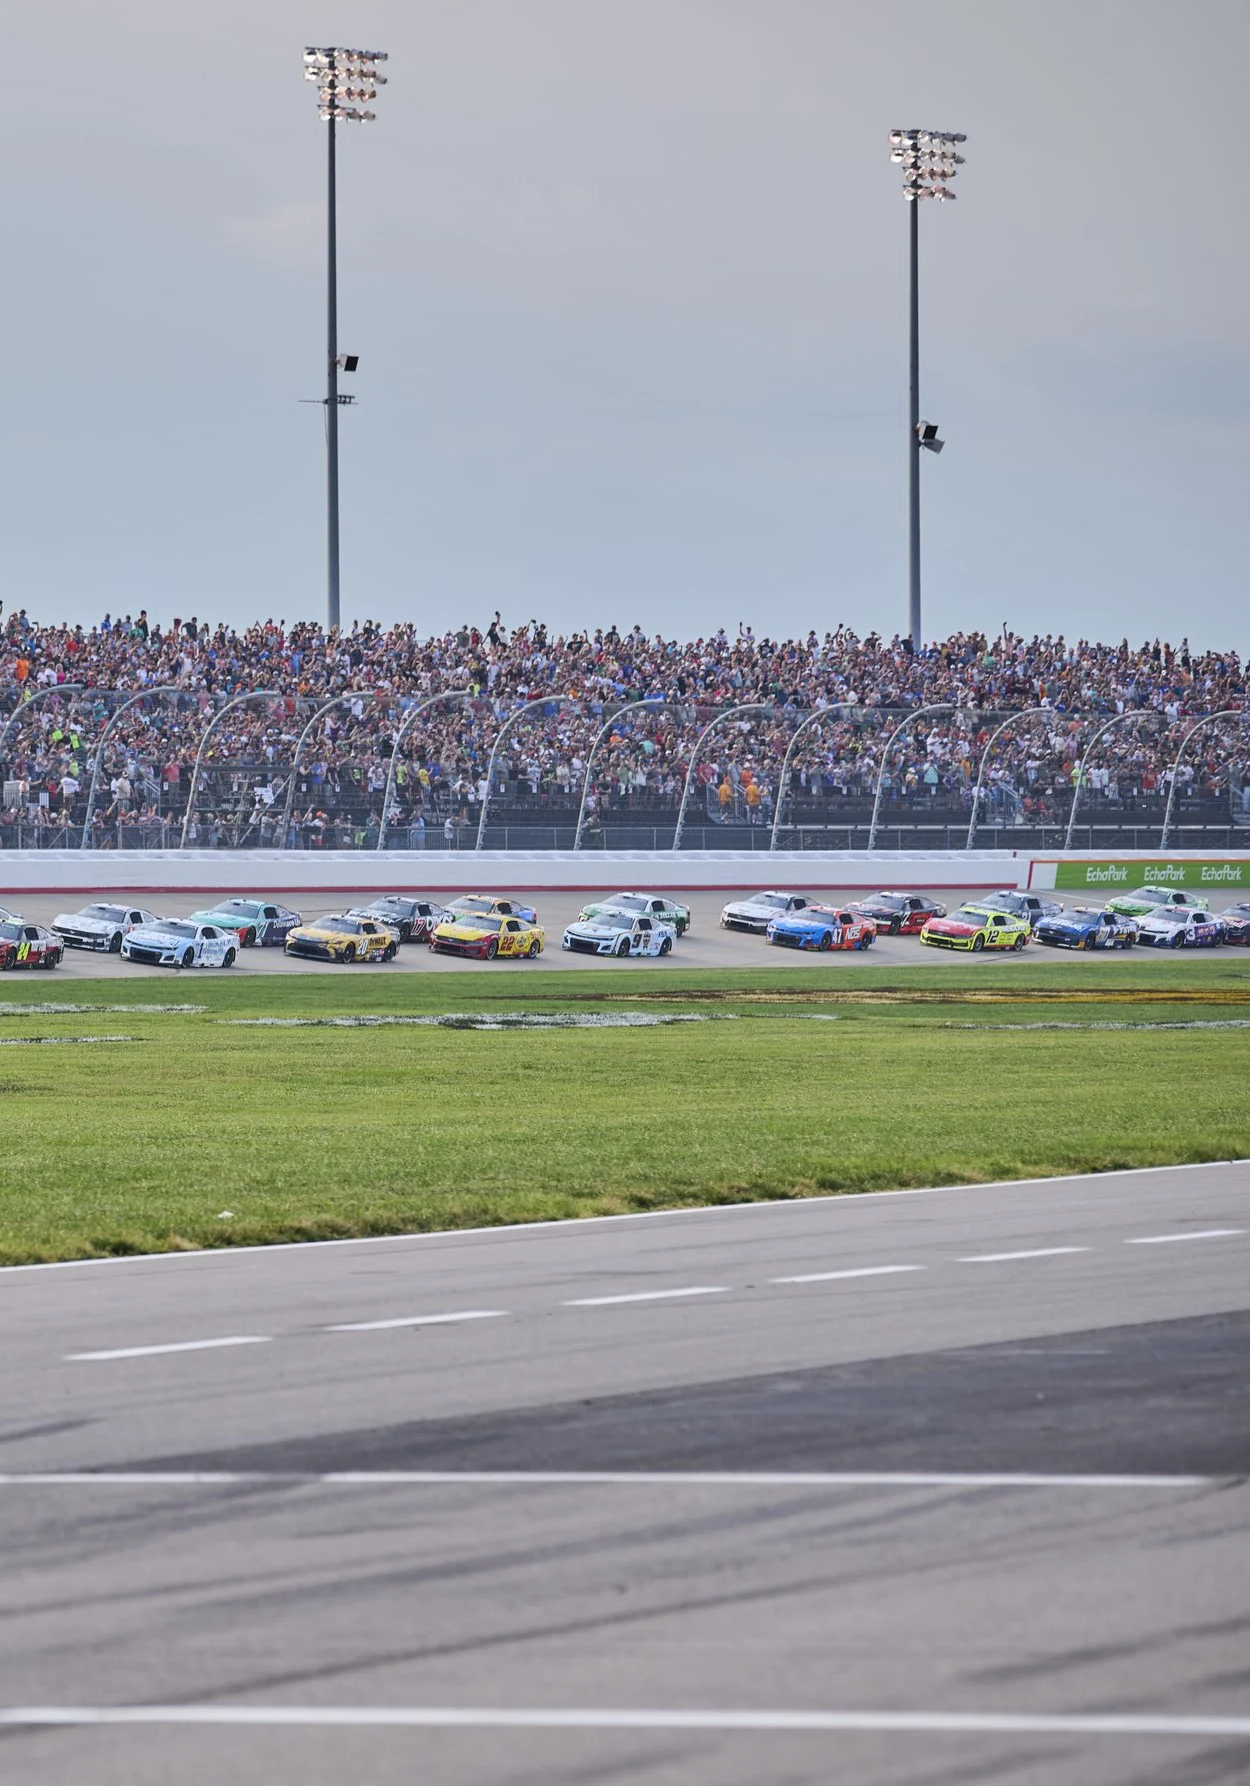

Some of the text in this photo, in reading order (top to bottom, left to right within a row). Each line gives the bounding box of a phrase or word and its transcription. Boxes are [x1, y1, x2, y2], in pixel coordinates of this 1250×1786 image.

[1086, 864, 1128, 882] EchoPark
[1144, 864, 1185, 881] EchoPark
[1201, 864, 1242, 881] EchoPark
[410, 917, 426, 935] 17
[1186, 927, 1196, 940] 3
[500, 936, 515, 951] 22
[631, 934, 643, 948] 9
[833, 928, 842, 943] 47
[986, 930, 1000, 943] 12
[17, 942, 31, 960] 24
[356, 938, 369, 955] 20
